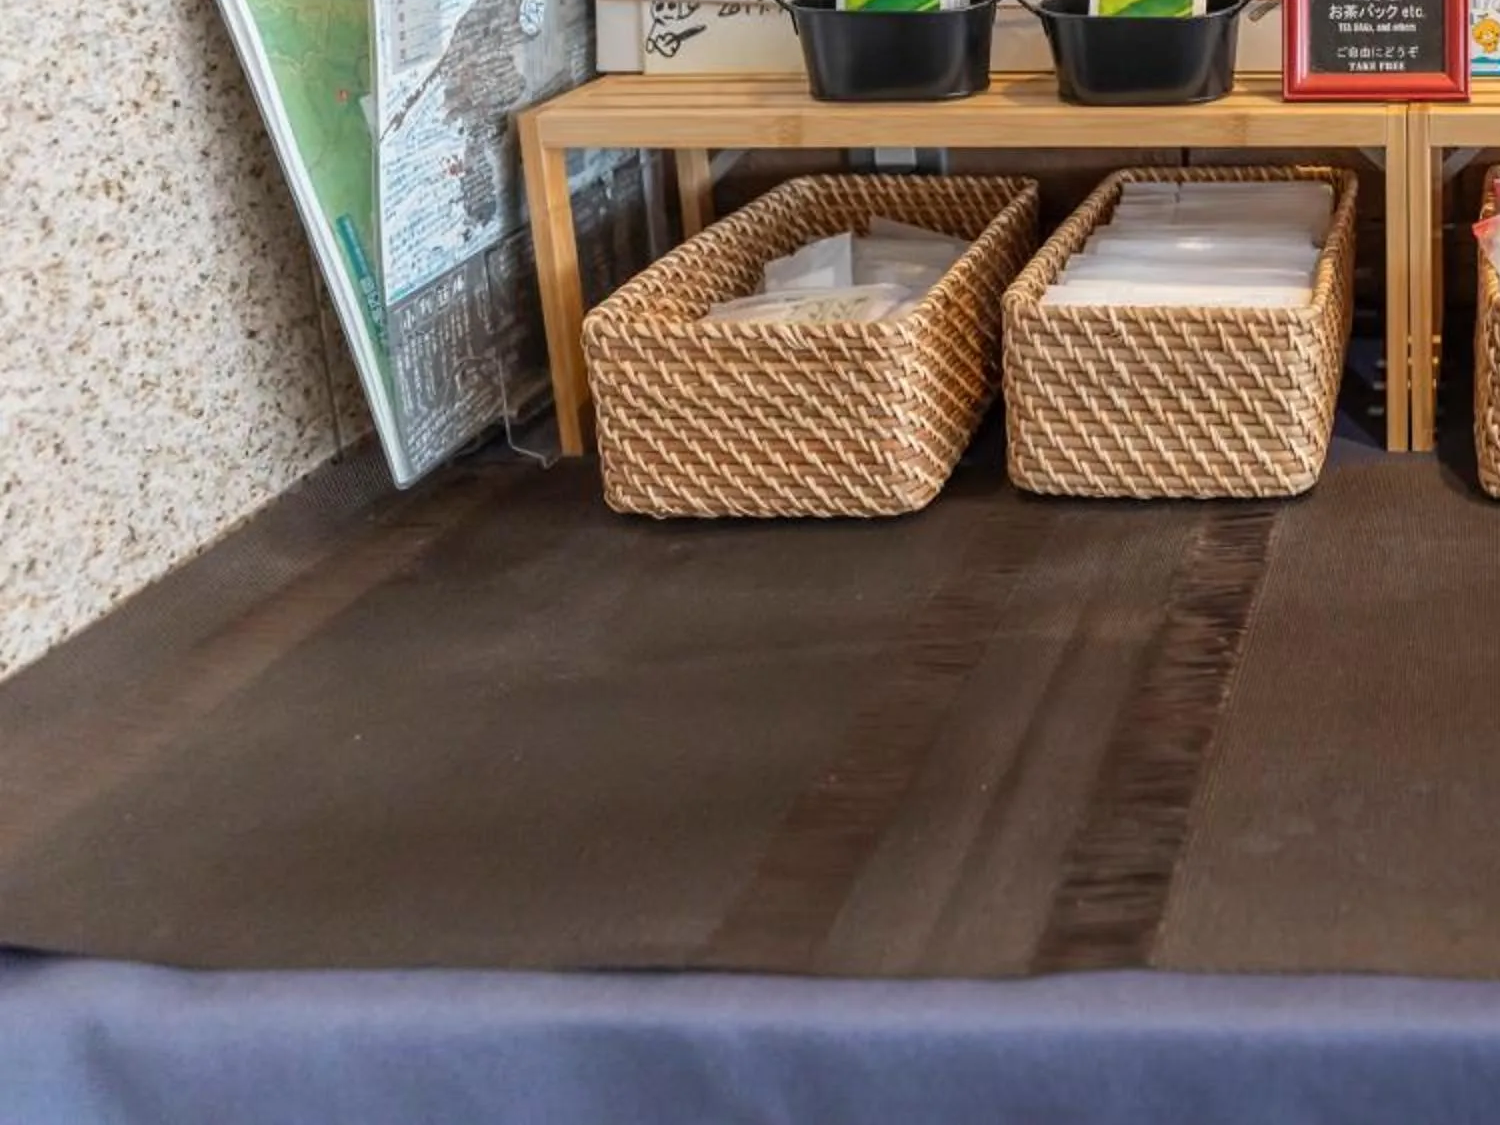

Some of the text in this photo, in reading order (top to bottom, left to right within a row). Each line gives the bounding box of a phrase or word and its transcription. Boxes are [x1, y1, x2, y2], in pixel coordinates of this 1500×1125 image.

[1329, 4, 1398, 20] お茶パック
[1337, 46, 1420, 58] ご自由にどうぞ
[1349, 61, 1406, 71] TAKE FREE
